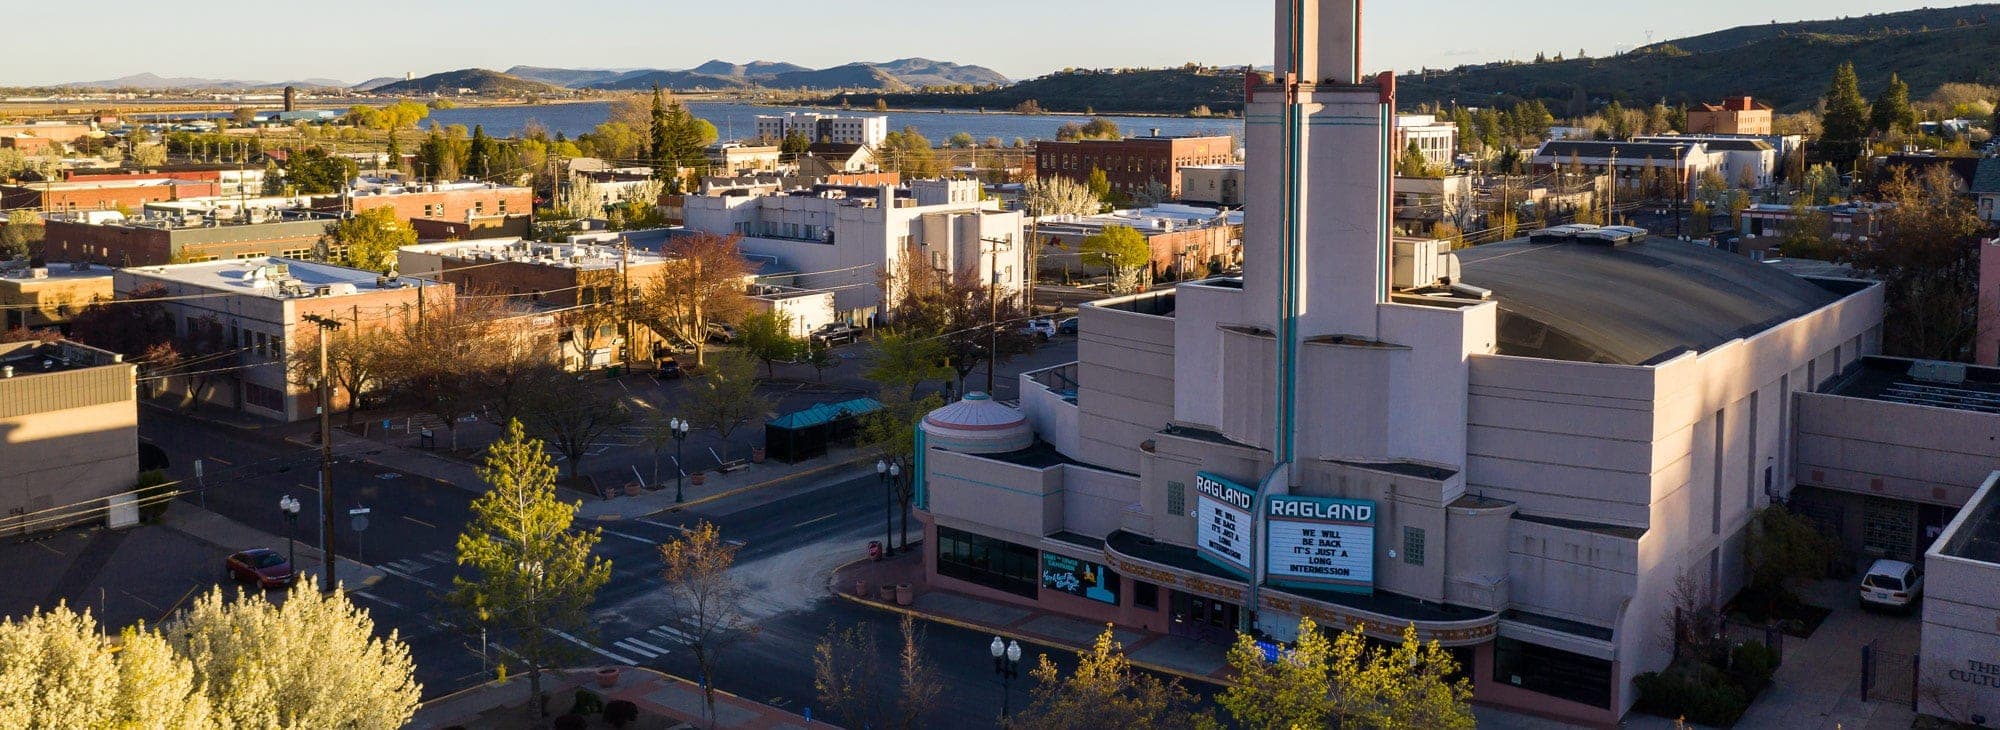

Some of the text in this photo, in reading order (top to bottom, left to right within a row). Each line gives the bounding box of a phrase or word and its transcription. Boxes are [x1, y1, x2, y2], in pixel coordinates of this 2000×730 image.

[1196, 475, 1250, 509] RAGLAND
[1214, 508, 1236, 522] WE WILL
[1271, 500, 1371, 520] RAGLAND
[1214, 516, 1236, 531] BE BACK
[1211, 524, 1239, 542] IT'S JUST A
[1302, 528, 1341, 539] WE WILL
[1218, 535, 1232, 547] LONG
[1302, 538, 1341, 548] BE BACK
[1208, 540, 1242, 560] INTERMISSION
[1294, 546, 1348, 558] IT'S JUST A
[1309, 557, 1332, 566] LONG
[1289, 564, 1350, 576] INTERMISSION
[1969, 659, 2000, 675] THE
